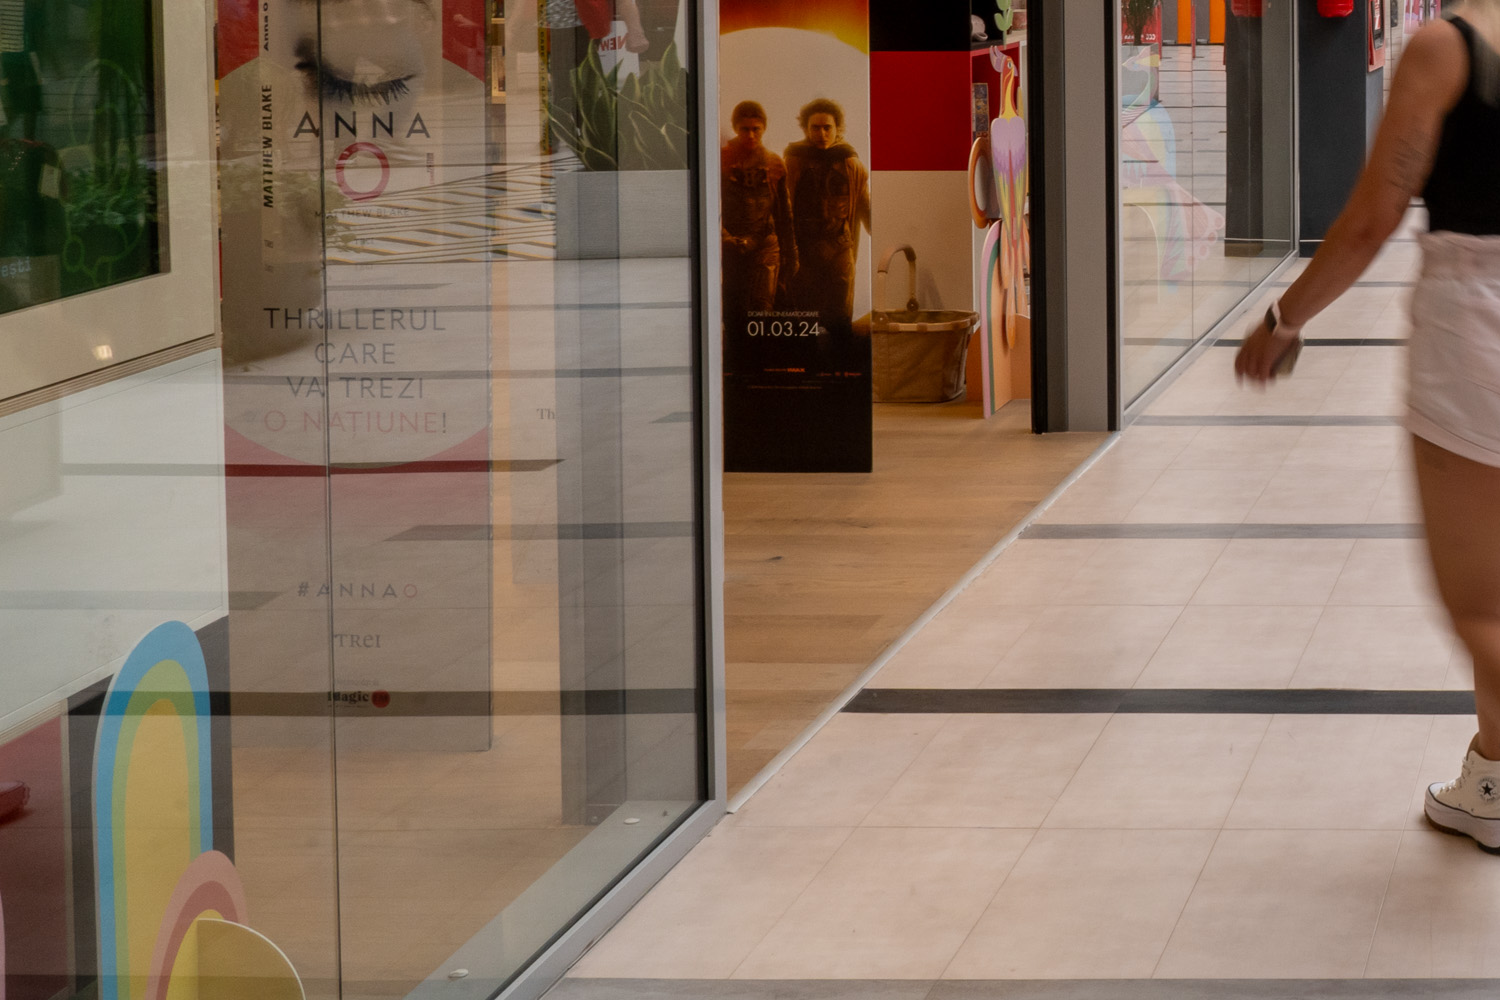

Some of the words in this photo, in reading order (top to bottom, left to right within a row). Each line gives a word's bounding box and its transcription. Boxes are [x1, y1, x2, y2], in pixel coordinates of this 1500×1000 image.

[261, 84, 273, 130] BLAKE
[293, 110, 430, 139] ANNA
[262, 137, 274, 208] MATTHEW
[335, 141, 390, 202] O
[264, 307, 447, 332] THRILLERUL
[747, 321, 820, 337] 01.03.24
[314, 342, 396, 365] CARE
[286, 376, 325, 398] VA
[340, 377, 424, 400] TREZI
[264, 410, 287, 432] O
[304, 411, 447, 439] NAȚIUNE!
[327, 691, 369, 704] Magic
